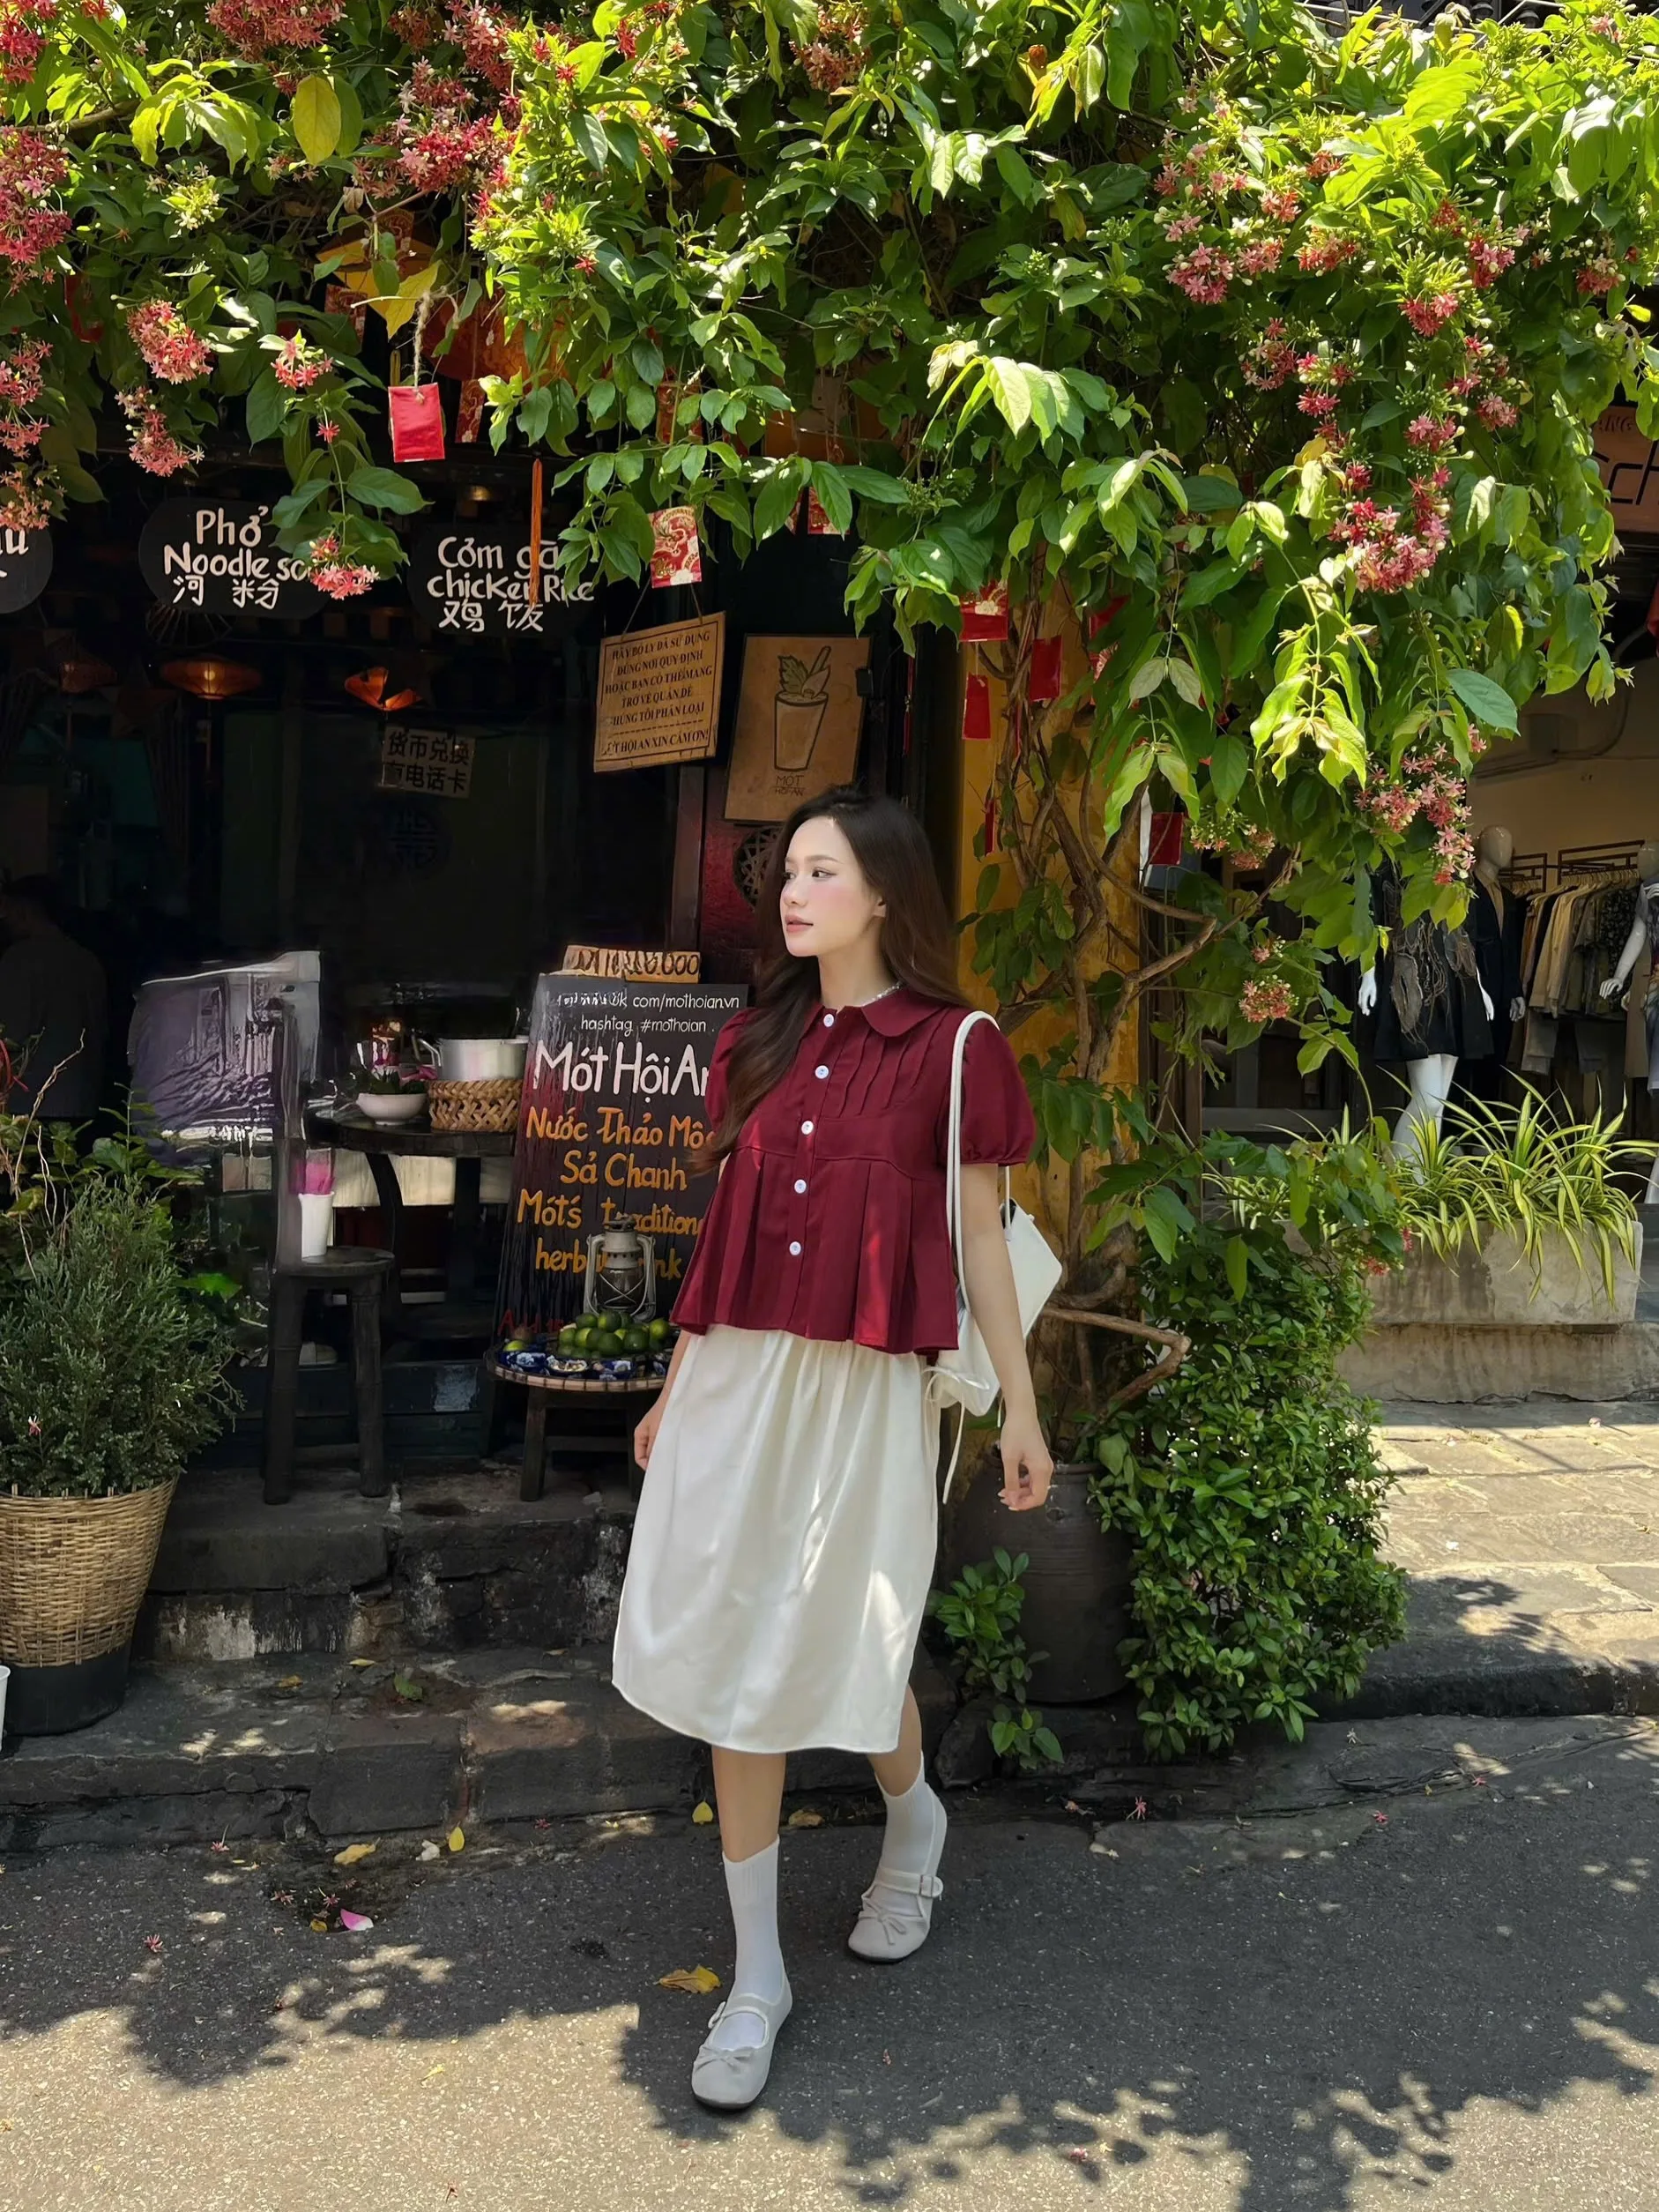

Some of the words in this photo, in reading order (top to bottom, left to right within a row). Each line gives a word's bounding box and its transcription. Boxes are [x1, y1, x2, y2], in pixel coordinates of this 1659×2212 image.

[196, 505, 269, 547] Phở
[163, 541, 270, 579] Noodle
[276, 557, 313, 581] so
[644, 643, 654, 655] LY
[684, 631, 710, 645] DỤNG
[659, 655, 678, 667] QUY
[609, 712, 637, 726] HÚNG
[387, 731, 470, 765] 货币兑换
[637, 738, 652, 749] AN
[652, 735, 668, 748] XIN
[581, 1015, 634, 1037] hashtag
[640, 1017, 706, 1032] #mothoian
[532, 1039, 609, 1093] Mót
[613, 1041, 671, 1103] Hội
[526, 1106, 589, 1142] Nước
[596, 1106, 663, 1146] Thảo
[560, 1150, 599, 1184] Sả
[604, 1152, 688, 1191] Chanh
